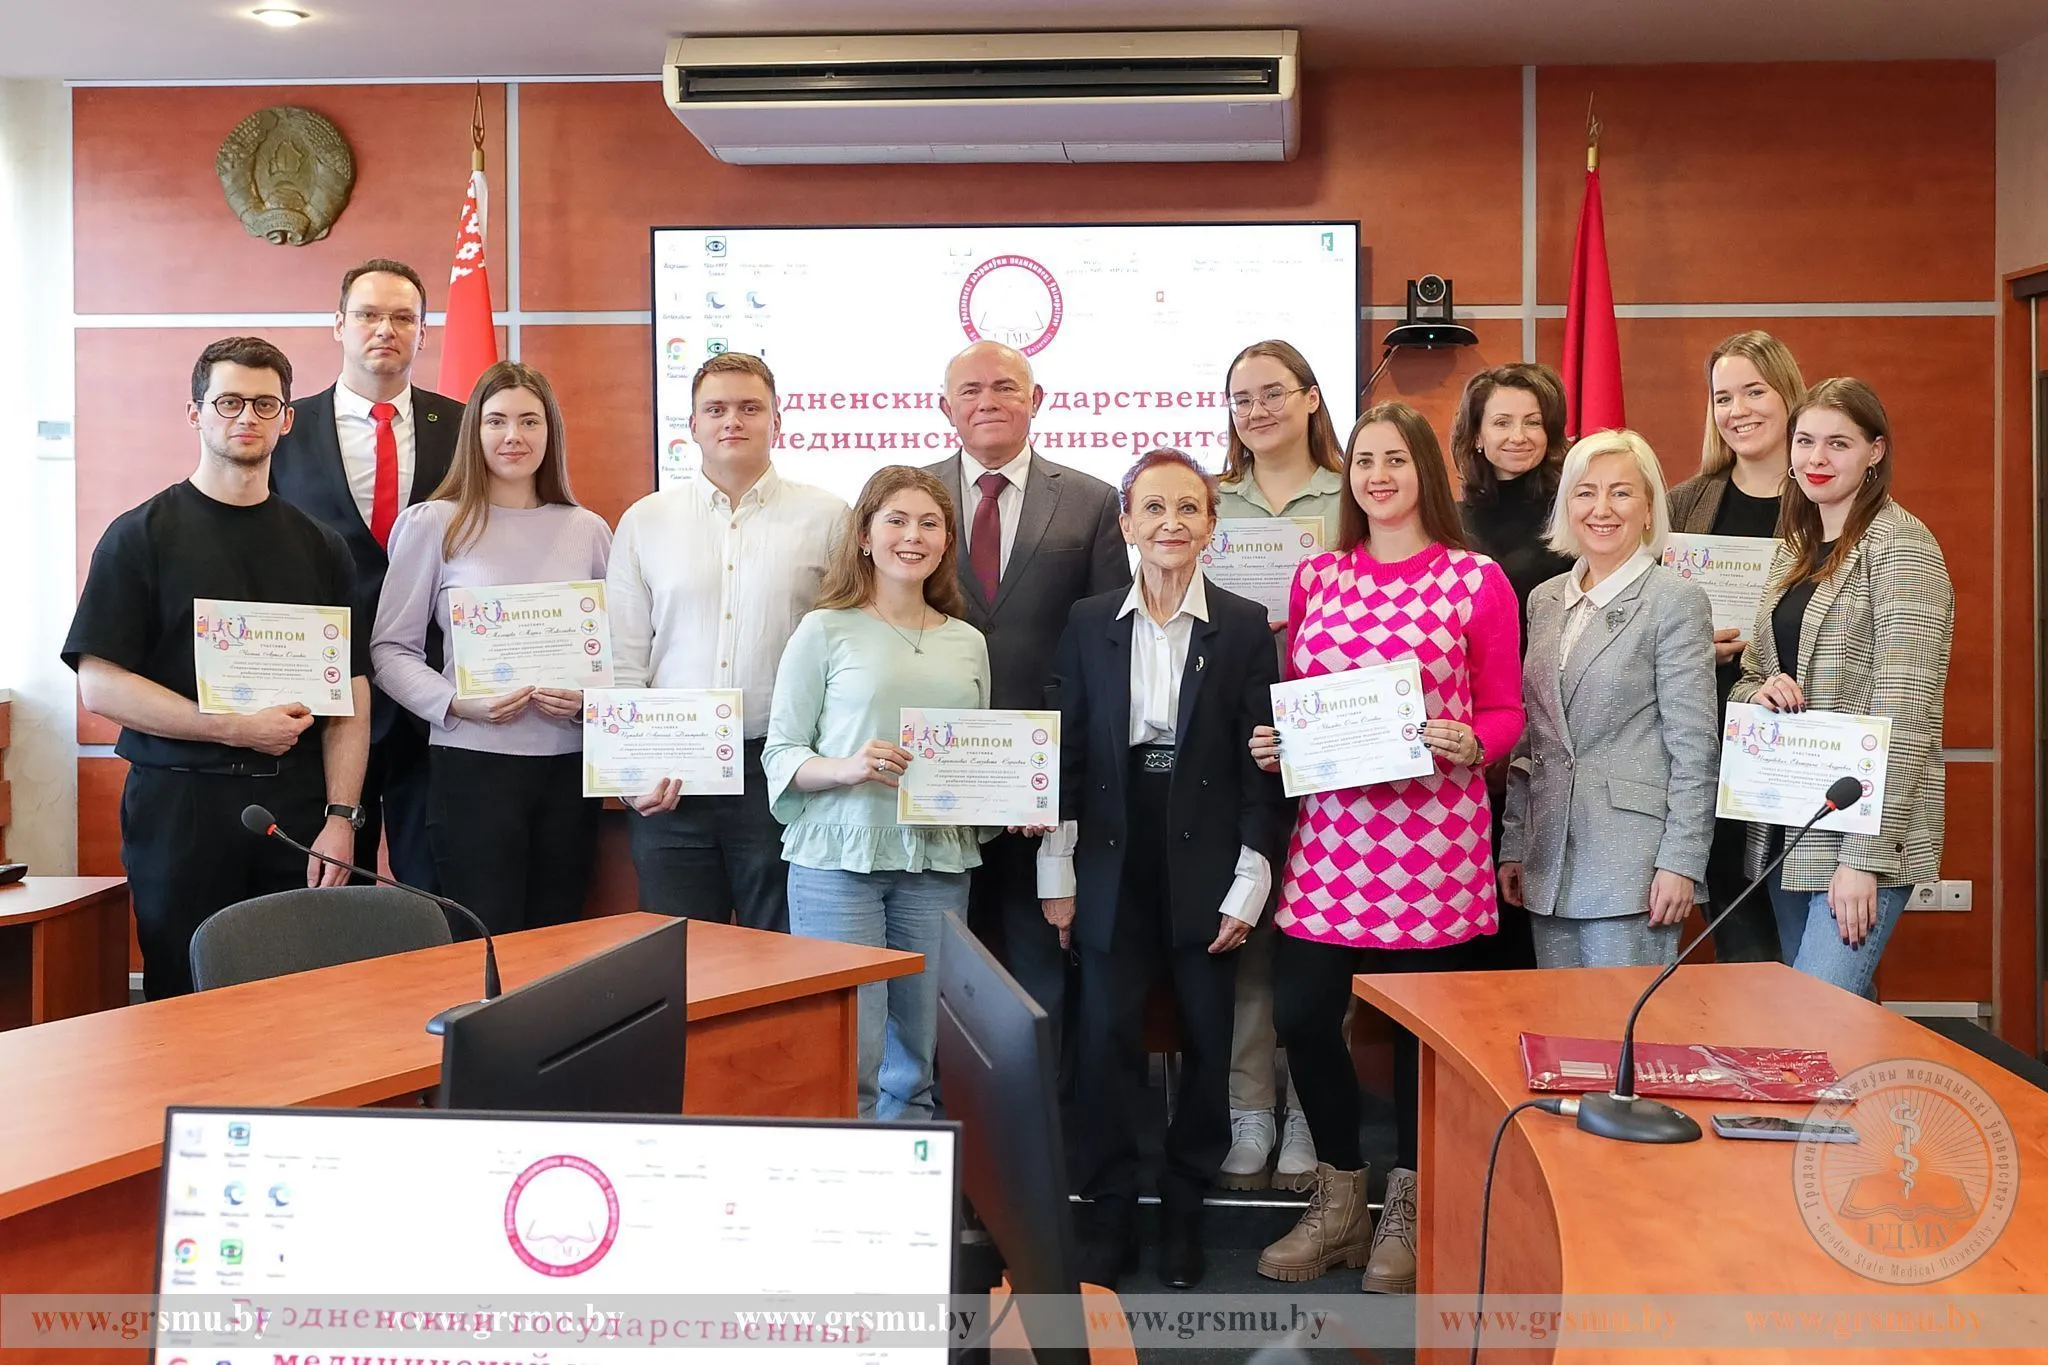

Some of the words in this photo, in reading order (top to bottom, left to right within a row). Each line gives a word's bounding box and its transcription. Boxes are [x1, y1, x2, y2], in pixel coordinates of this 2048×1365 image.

[776, 391, 944, 412] дненски
[771, 431, 962, 451] медицинск
[1028, 431, 1226, 454] университе
[1227, 542, 1284, 554] ДИПЛОМ
[1707, 560, 1762, 571] ДИПЛОМ
[502, 608, 562, 622] ДИПЛОМ
[244, 629, 305, 641] ДИПЛОМ
[1320, 694, 1379, 713] ДИПЛОМ
[635, 712, 697, 723] ДИПЛОМ
[950, 737, 1012, 748] ДИПЛОМ
[1776, 736, 1842, 751] ДИПЛОМ
